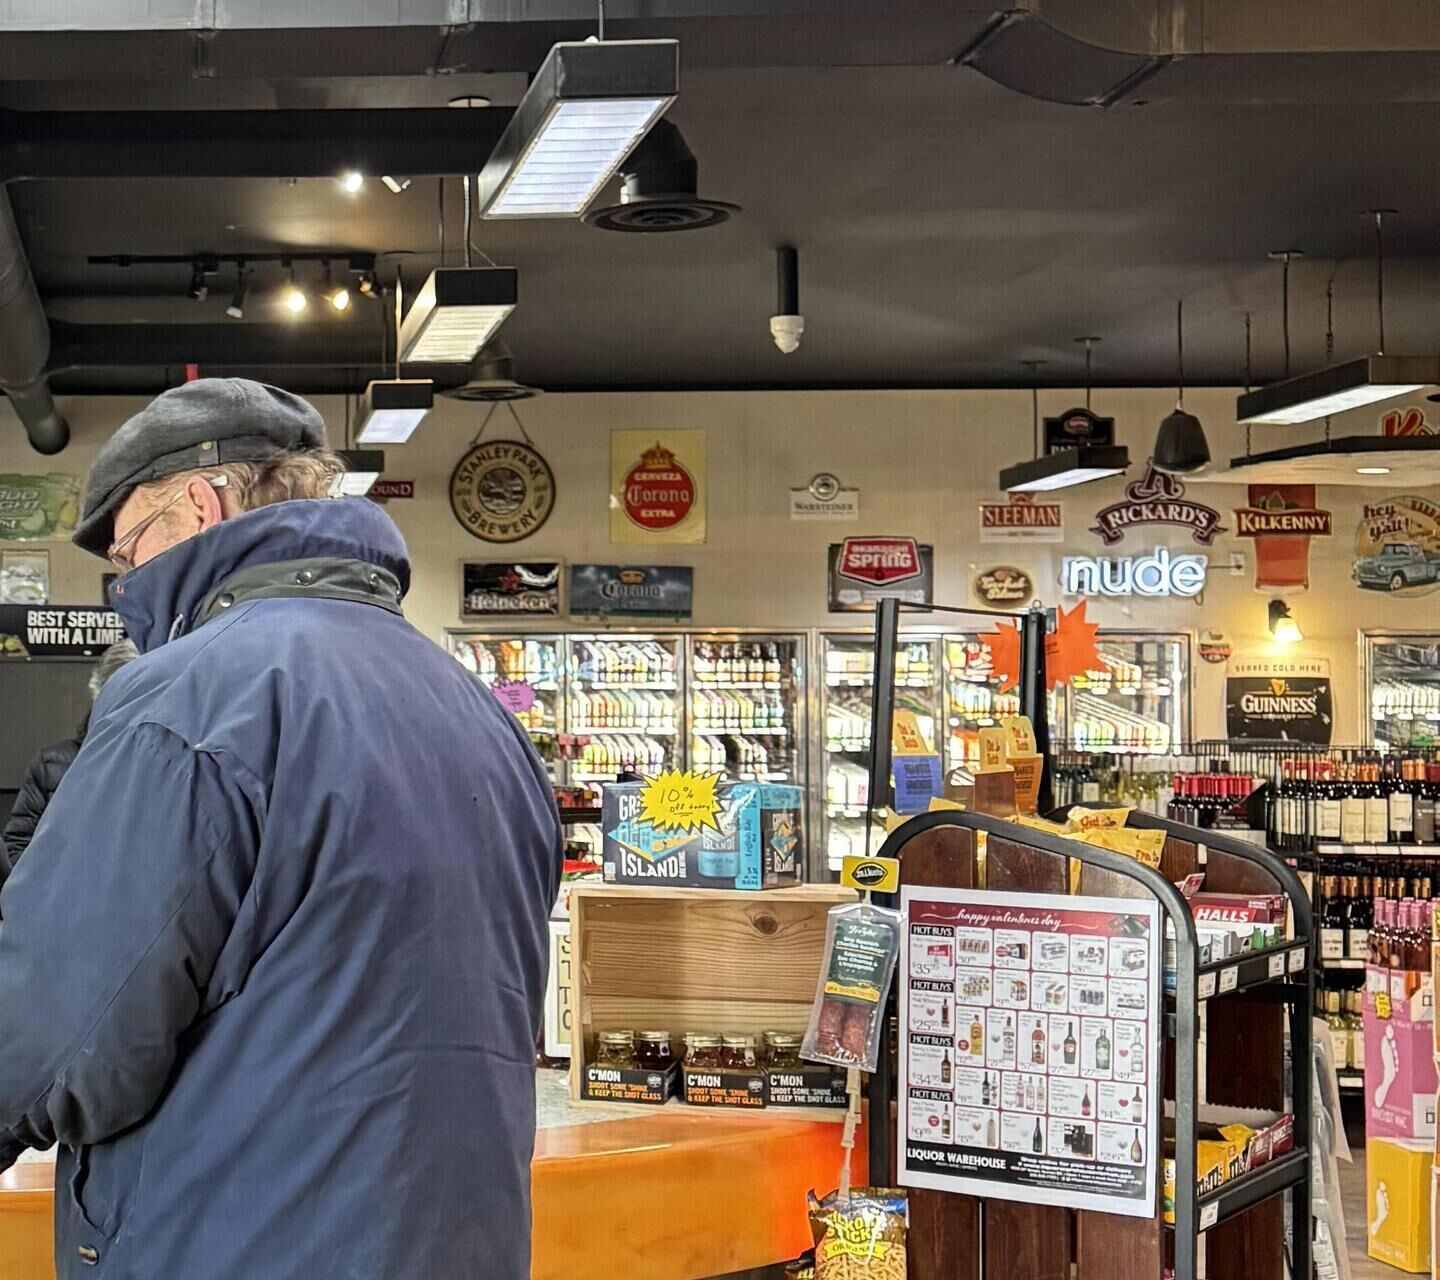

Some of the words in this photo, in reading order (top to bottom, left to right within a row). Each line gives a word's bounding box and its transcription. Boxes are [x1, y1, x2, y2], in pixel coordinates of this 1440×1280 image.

[459, 447, 510, 485] STANLEY
[512, 449, 547, 479] PARK
[634, 472, 682, 481] CERVEZA
[372, 484, 411, 495] OUND
[627, 485, 689, 506] Corona
[641, 509, 676, 518] EXTRA
[794, 502, 854, 512] WARSTEINER
[467, 508, 538, 535] BREWERY
[984, 506, 1059, 527] SLEEMAN
[1106, 503, 1210, 528] RICKARD'S
[1240, 513, 1326, 533] KILKENNY
[1065, 547, 1206, 596] nude
[470, 593, 550, 610] Heineken
[27, 611, 65, 627] BEST
[67, 612, 124, 628] SERVED
[27, 628, 70, 645] WITH
[71, 628, 83, 645] A
[86, 629, 124, 645] LIME
[1272, 664, 1296, 672] COLD
[1299, 665, 1322, 673] HERE
[1240, 694, 1317, 714] GUINNESS
[660, 787, 694, 804] 10%
[619, 846, 680, 878] ISLAND
[957, 908, 991, 926] happy
[991, 911, 1039, 925] valentines
[1041, 914, 1062, 931] day
[1195, 909, 1250, 922] HALLS
[913, 926, 930, 935] HOT
[932, 927, 952, 936] BUYS
[913, 980, 930, 989] HOT
[932, 982, 952, 991] BUYS
[912, 1035, 930, 1044] HOT
[931, 1037, 951, 1046] BUYS
[588, 1069, 621, 1082] C'MON
[688, 1075, 721, 1088] C'MON
[770, 1075, 803, 1087] C'MON
[588, 1082, 608, 1090] SHOOT
[688, 1088, 708, 1096] SHOOT
[710, 1088, 728, 1096] SOME
[770, 1087, 791, 1095] SHOOT
[793, 1088, 810, 1096] SOME
[642, 1092, 662, 1101] GLASS
[712, 1096, 724, 1104] THE
[725, 1097, 741, 1105] SHOT
[743, 1097, 762, 1106] GLASS
[777, 1095, 792, 1103] KEEP
[794, 1095, 806, 1103] THE
[807, 1095, 823, 1104] SHOT
[825, 1096, 846, 1104] GLASS
[912, 1090, 929, 1098] HOT
[931, 1091, 951, 1101] BUYS
[907, 1148, 944, 1162] LIQUOR
[947, 1152, 1006, 1170] WAREHOUSE
